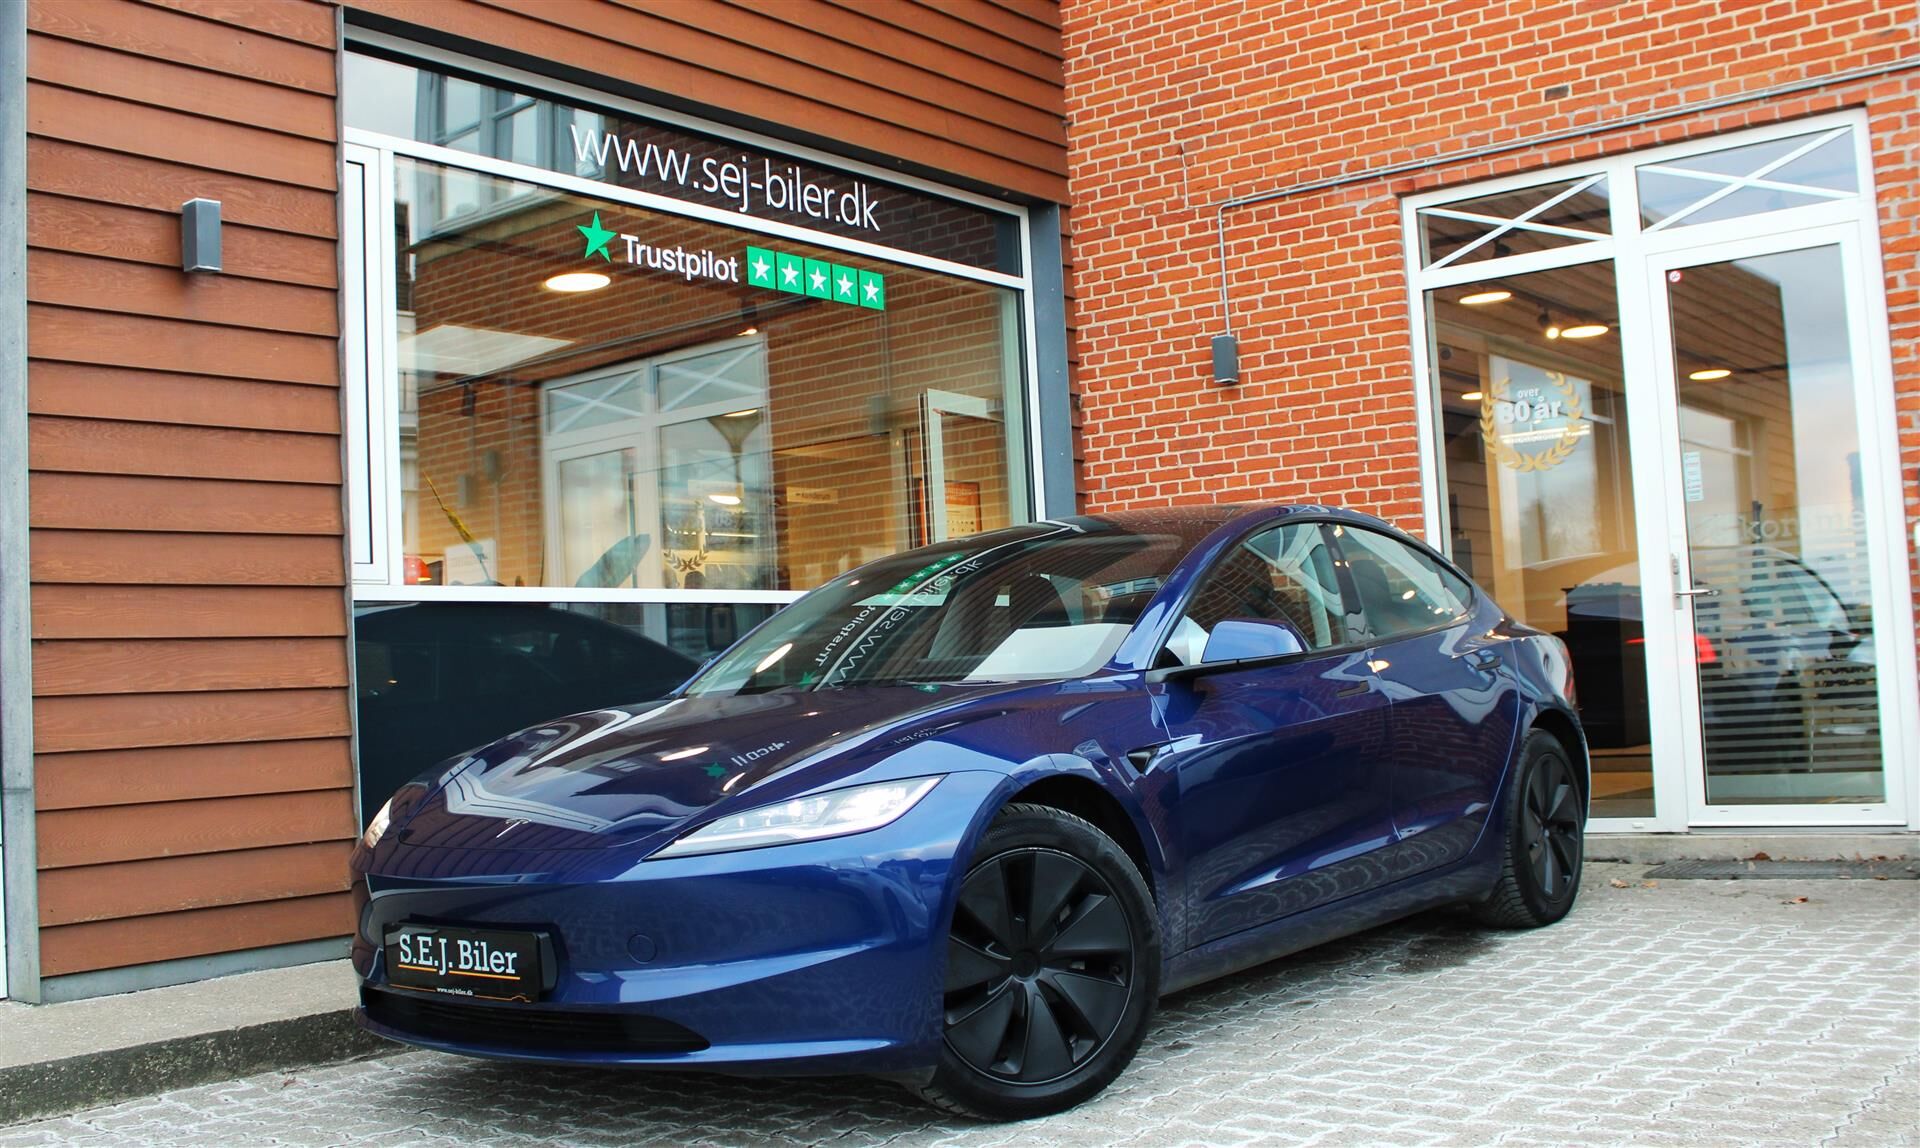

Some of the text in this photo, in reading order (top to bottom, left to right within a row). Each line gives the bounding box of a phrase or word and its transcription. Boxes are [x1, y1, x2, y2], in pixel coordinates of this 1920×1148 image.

[570, 124, 880, 231] www.sej-biler.dk
[620, 234, 739, 283] Trustpilot
[1517, 387, 1540, 399] over
[1533, 395, 1562, 419] år
[399, 933, 518, 975] S.E.J. Biler
